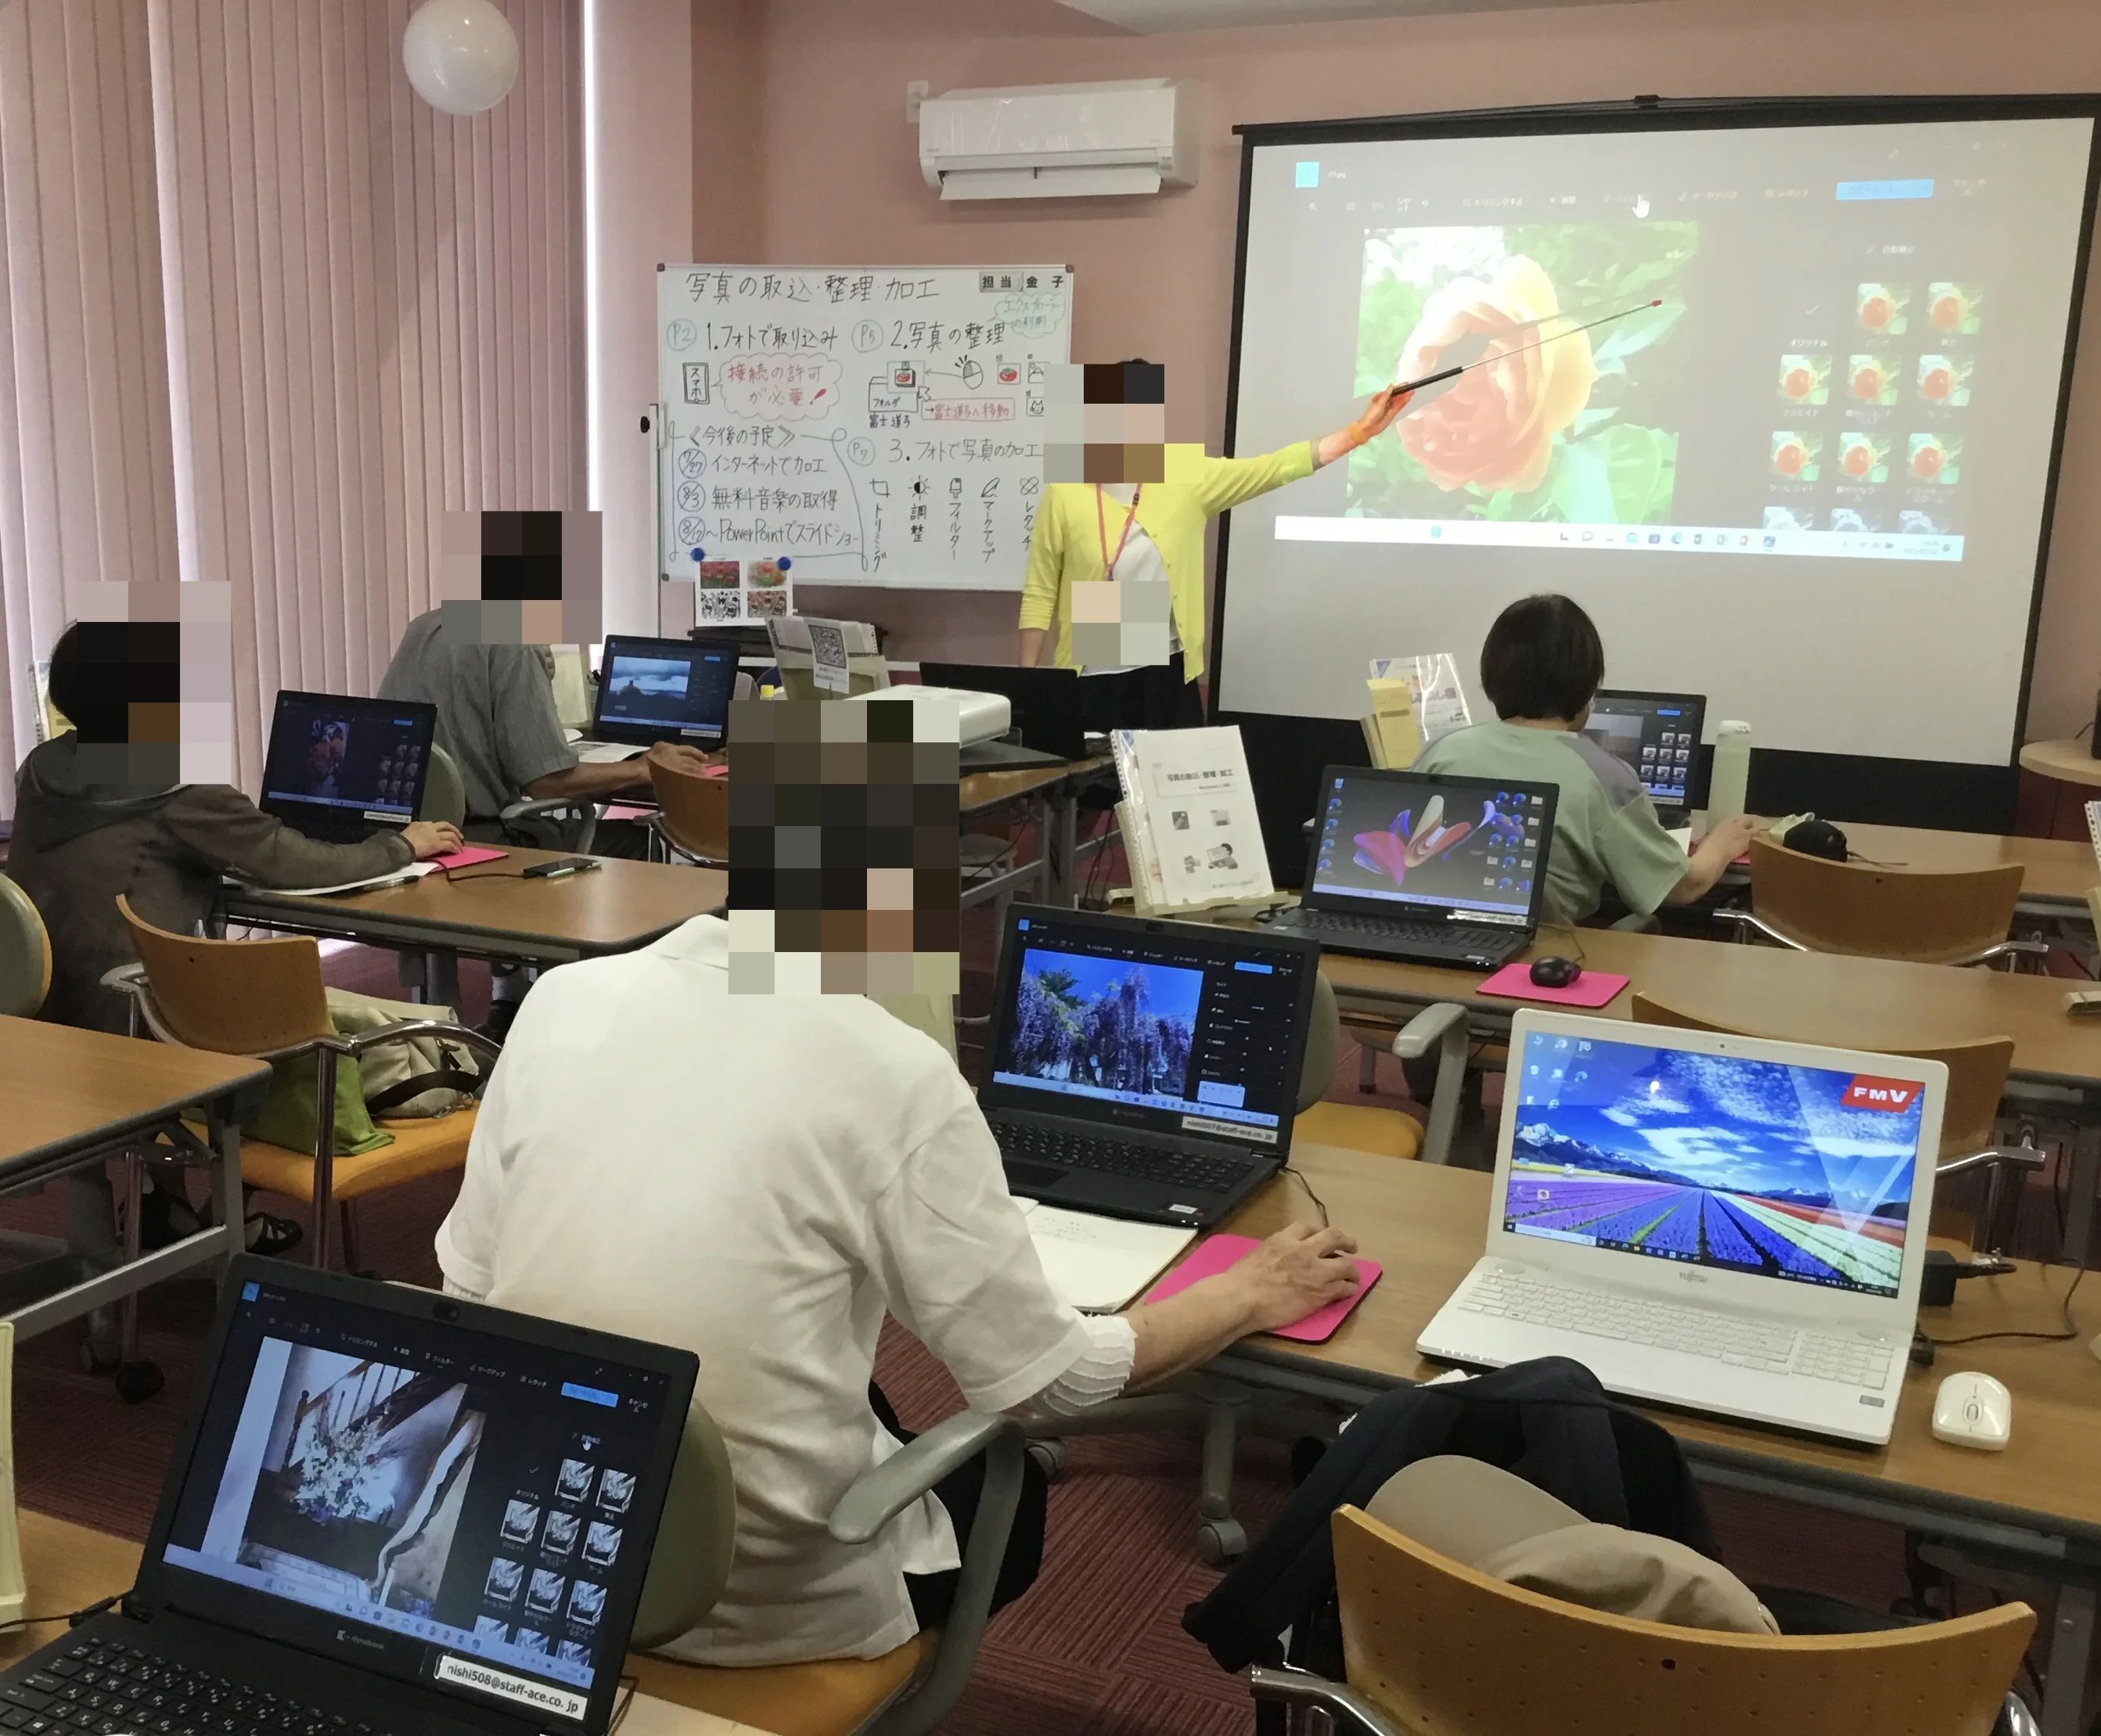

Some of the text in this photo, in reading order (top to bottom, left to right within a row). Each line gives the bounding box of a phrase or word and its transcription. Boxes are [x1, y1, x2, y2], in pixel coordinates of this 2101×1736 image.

[982, 275, 1064, 289] 担当 金子
[890, 320, 1005, 353] 2.写真の整理
[690, 368, 702, 397] スマホ
[728, 361, 824, 383] 接続の許可
[711, 453, 828, 476] インターネットで加工
[711, 484, 838, 513] 無料音楽の取得
[909, 503, 927, 543] 調整
[1853, 1086, 1909, 1103] FMV
